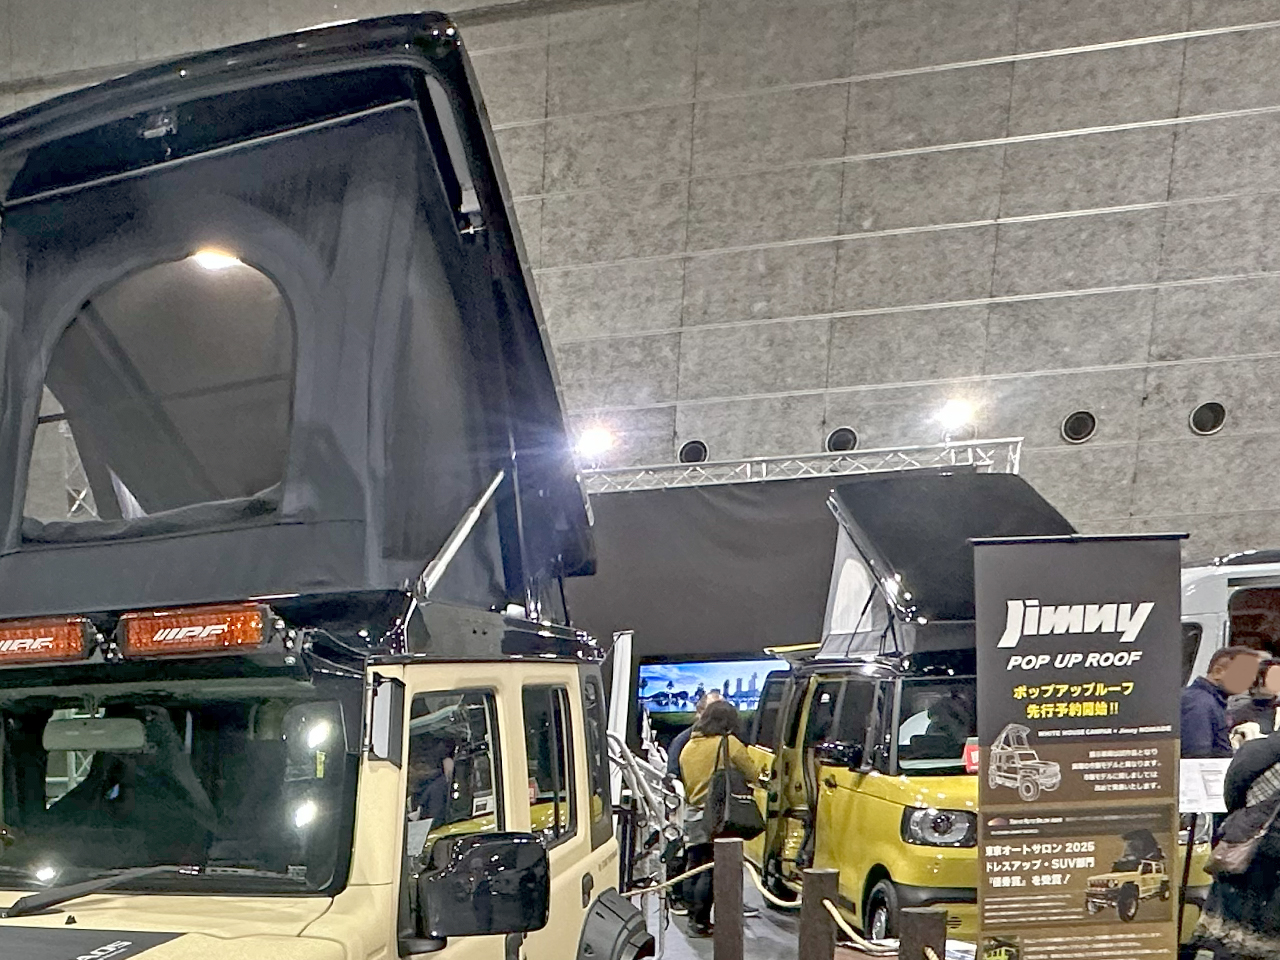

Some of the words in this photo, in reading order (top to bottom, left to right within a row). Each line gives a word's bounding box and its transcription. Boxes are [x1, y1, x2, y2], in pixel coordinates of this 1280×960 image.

[997, 599, 1155, 648] Jimny
[152, 624, 230, 642] IPF
[1006, 654, 1050, 670] POP
[1054, 653, 1083, 668] UP
[1085, 651, 1142, 667] ROOF
[1013, 681, 1135, 699] ポップアップルーフ
[985, 844, 1062, 857] 東京オートサロン
[1065, 842, 1095, 853] 2025
